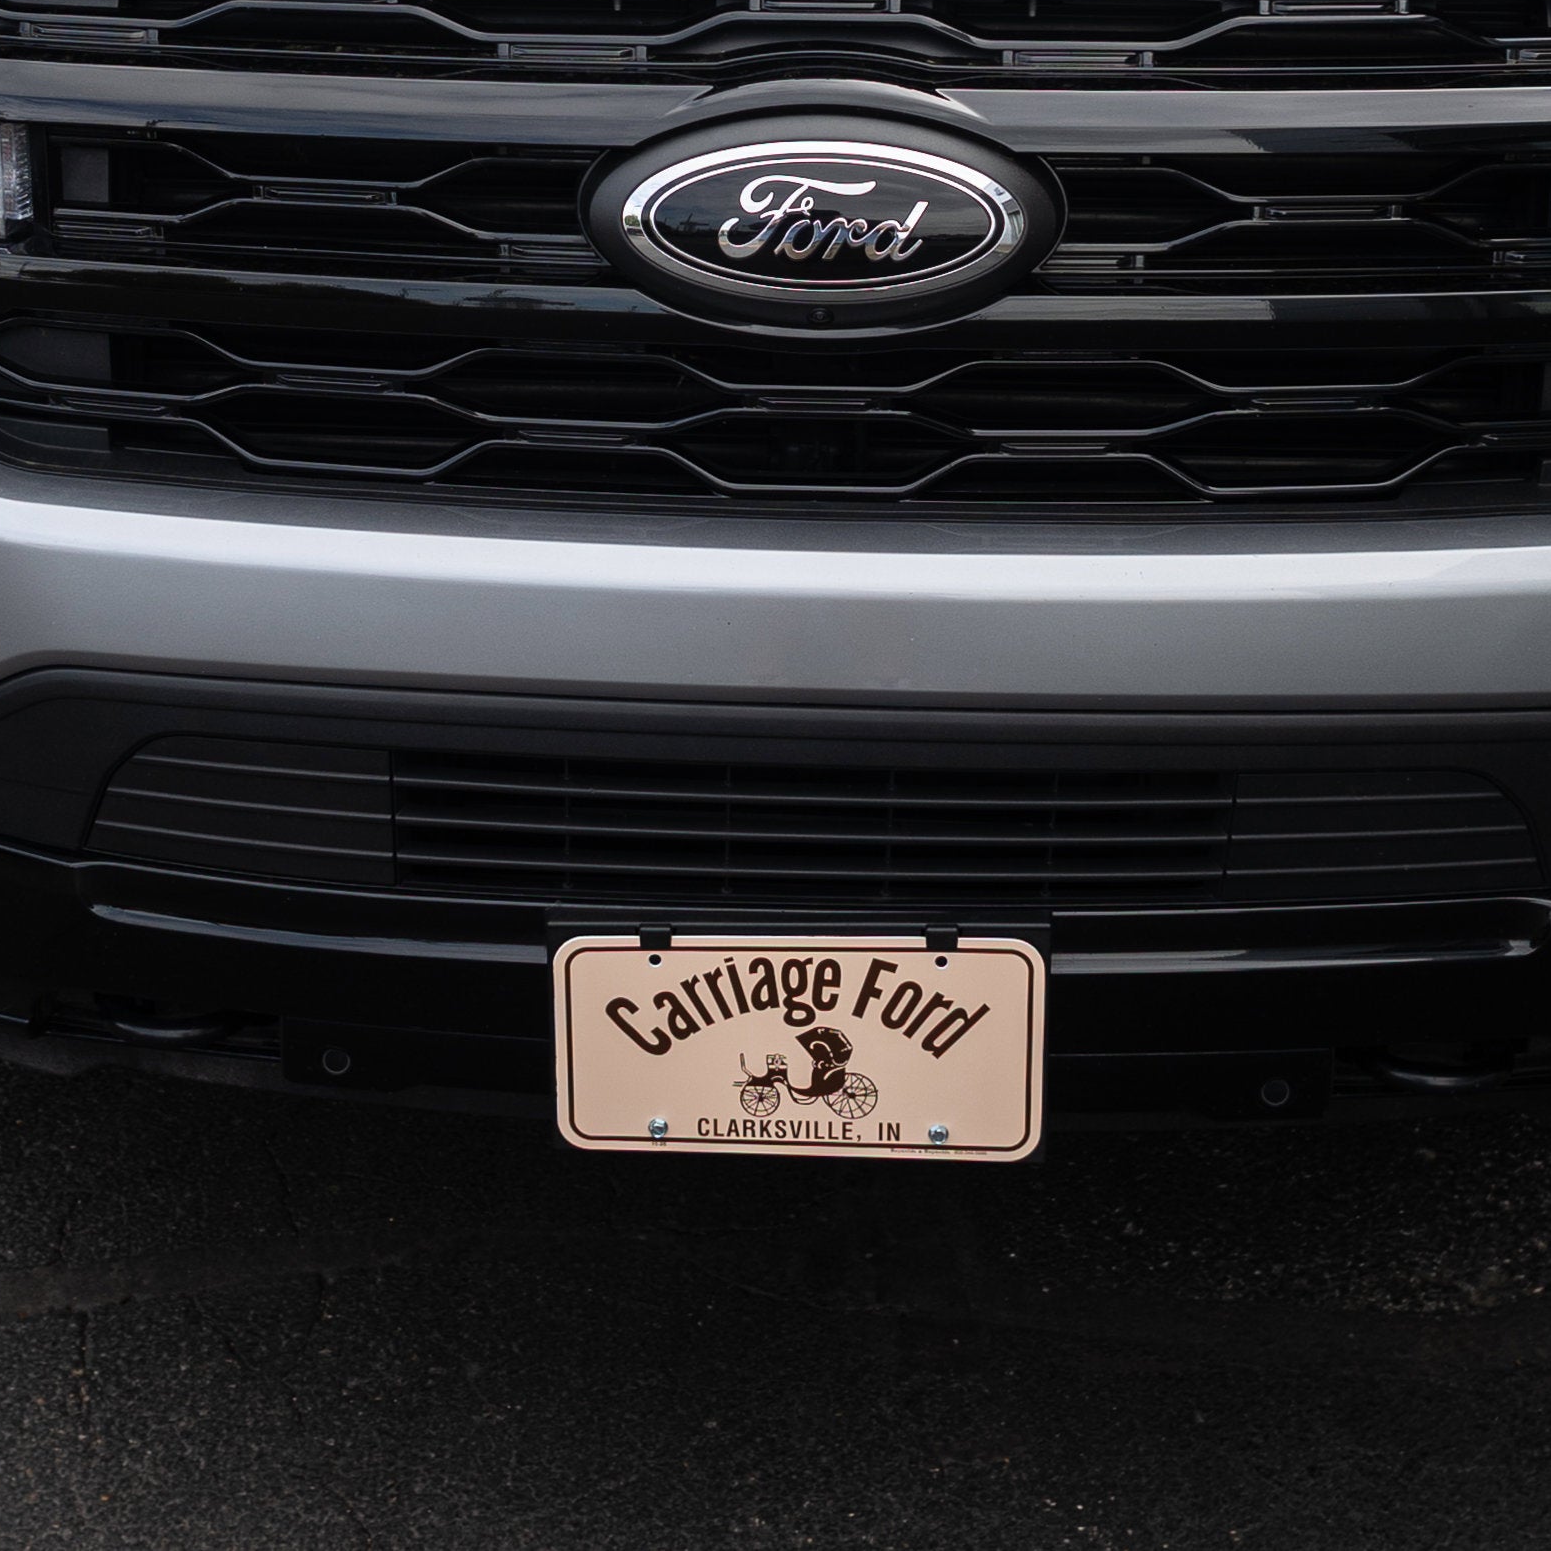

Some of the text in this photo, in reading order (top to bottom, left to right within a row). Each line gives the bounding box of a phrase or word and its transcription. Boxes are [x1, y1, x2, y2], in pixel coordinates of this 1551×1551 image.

[717, 173, 930, 263] Ford
[604, 956, 992, 1060] Carriage Ford
[697, 1117, 902, 1143] CLARKSVILLE, IN
